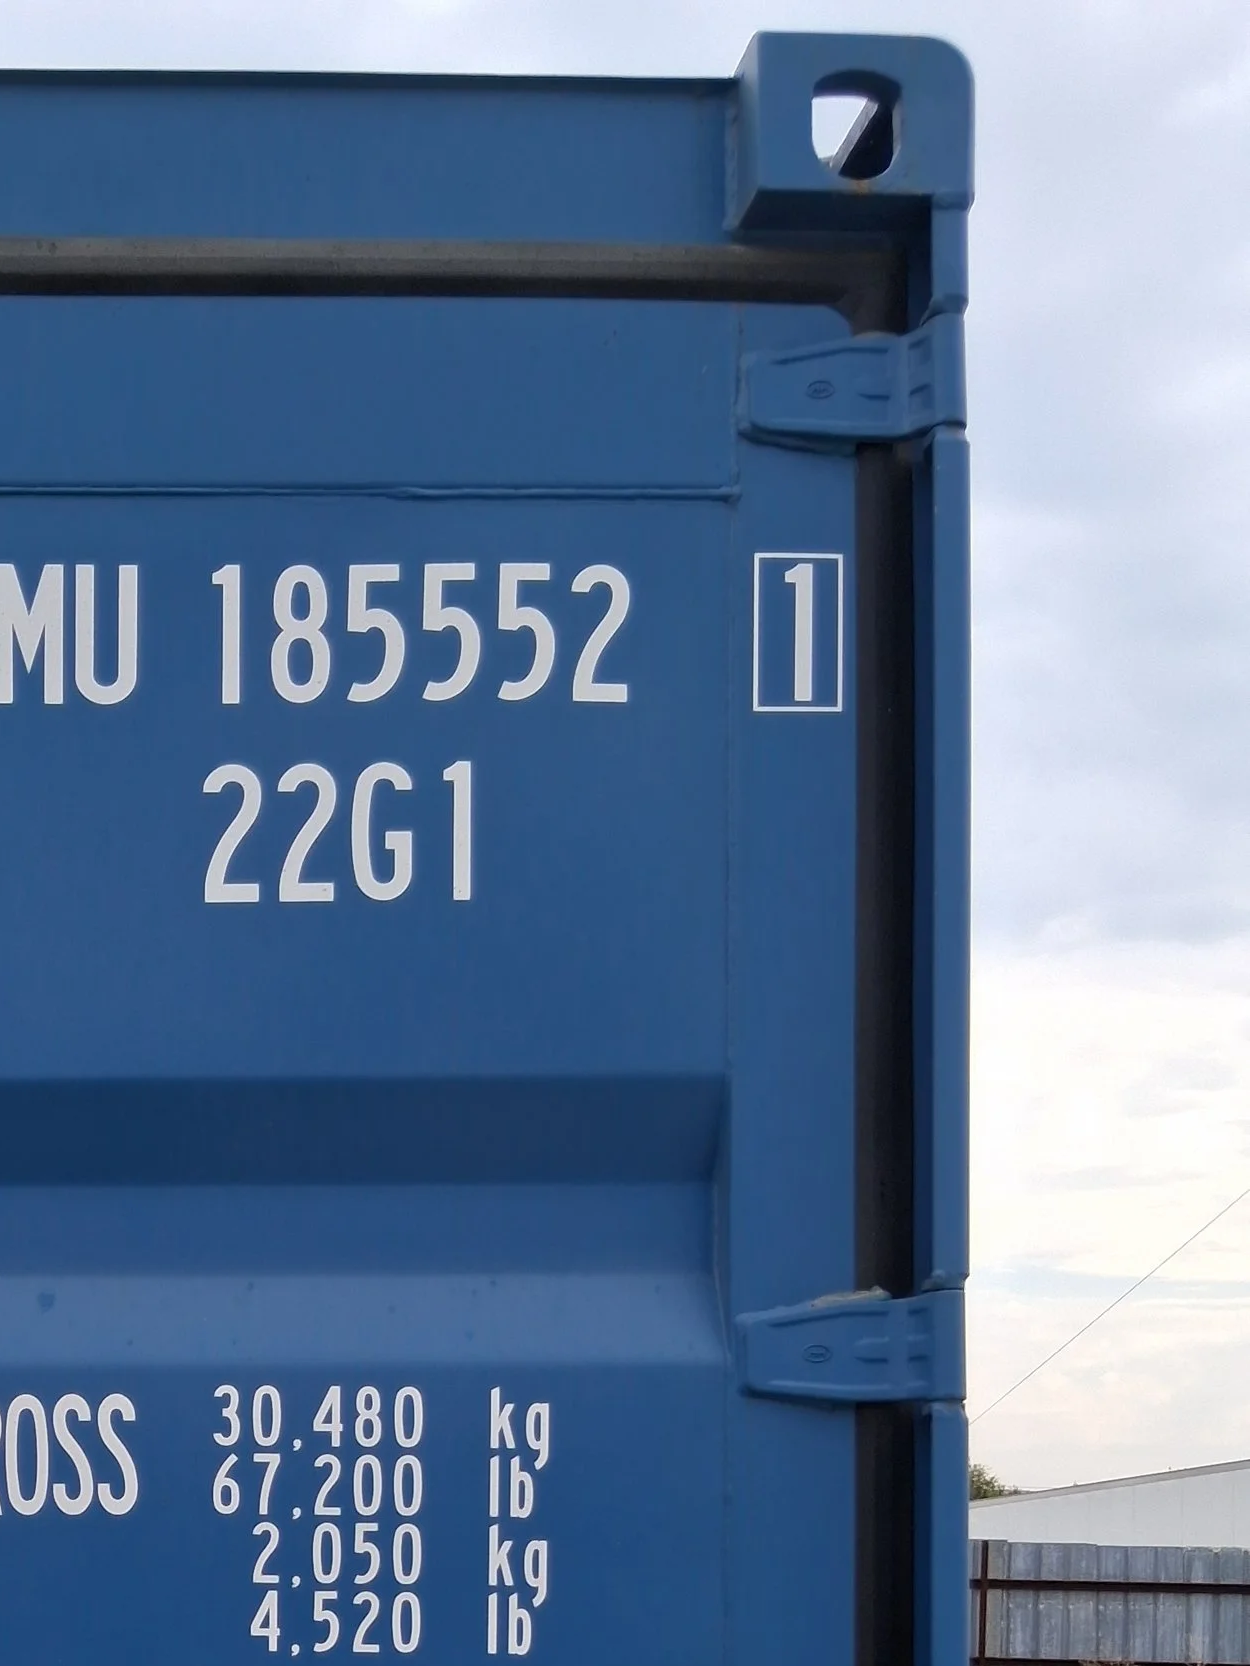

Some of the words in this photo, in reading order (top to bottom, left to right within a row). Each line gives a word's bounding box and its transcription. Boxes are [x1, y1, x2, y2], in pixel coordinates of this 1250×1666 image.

[211, 562, 631, 705] 185552
[784, 562, 814, 702] 1
[202, 760, 472, 904] 22G1
[212, 1384, 424, 1452] 30,480
[490, 1386, 550, 1471] kg
[212, 1452, 423, 1520] 67,200
[489, 1454, 534, 1519] lb
[252, 1521, 422, 1588] 2,050
[488, 1523, 548, 1608] kg
[250, 1589, 421, 1657] 4,520
[487, 1592, 532, 1656] lb
